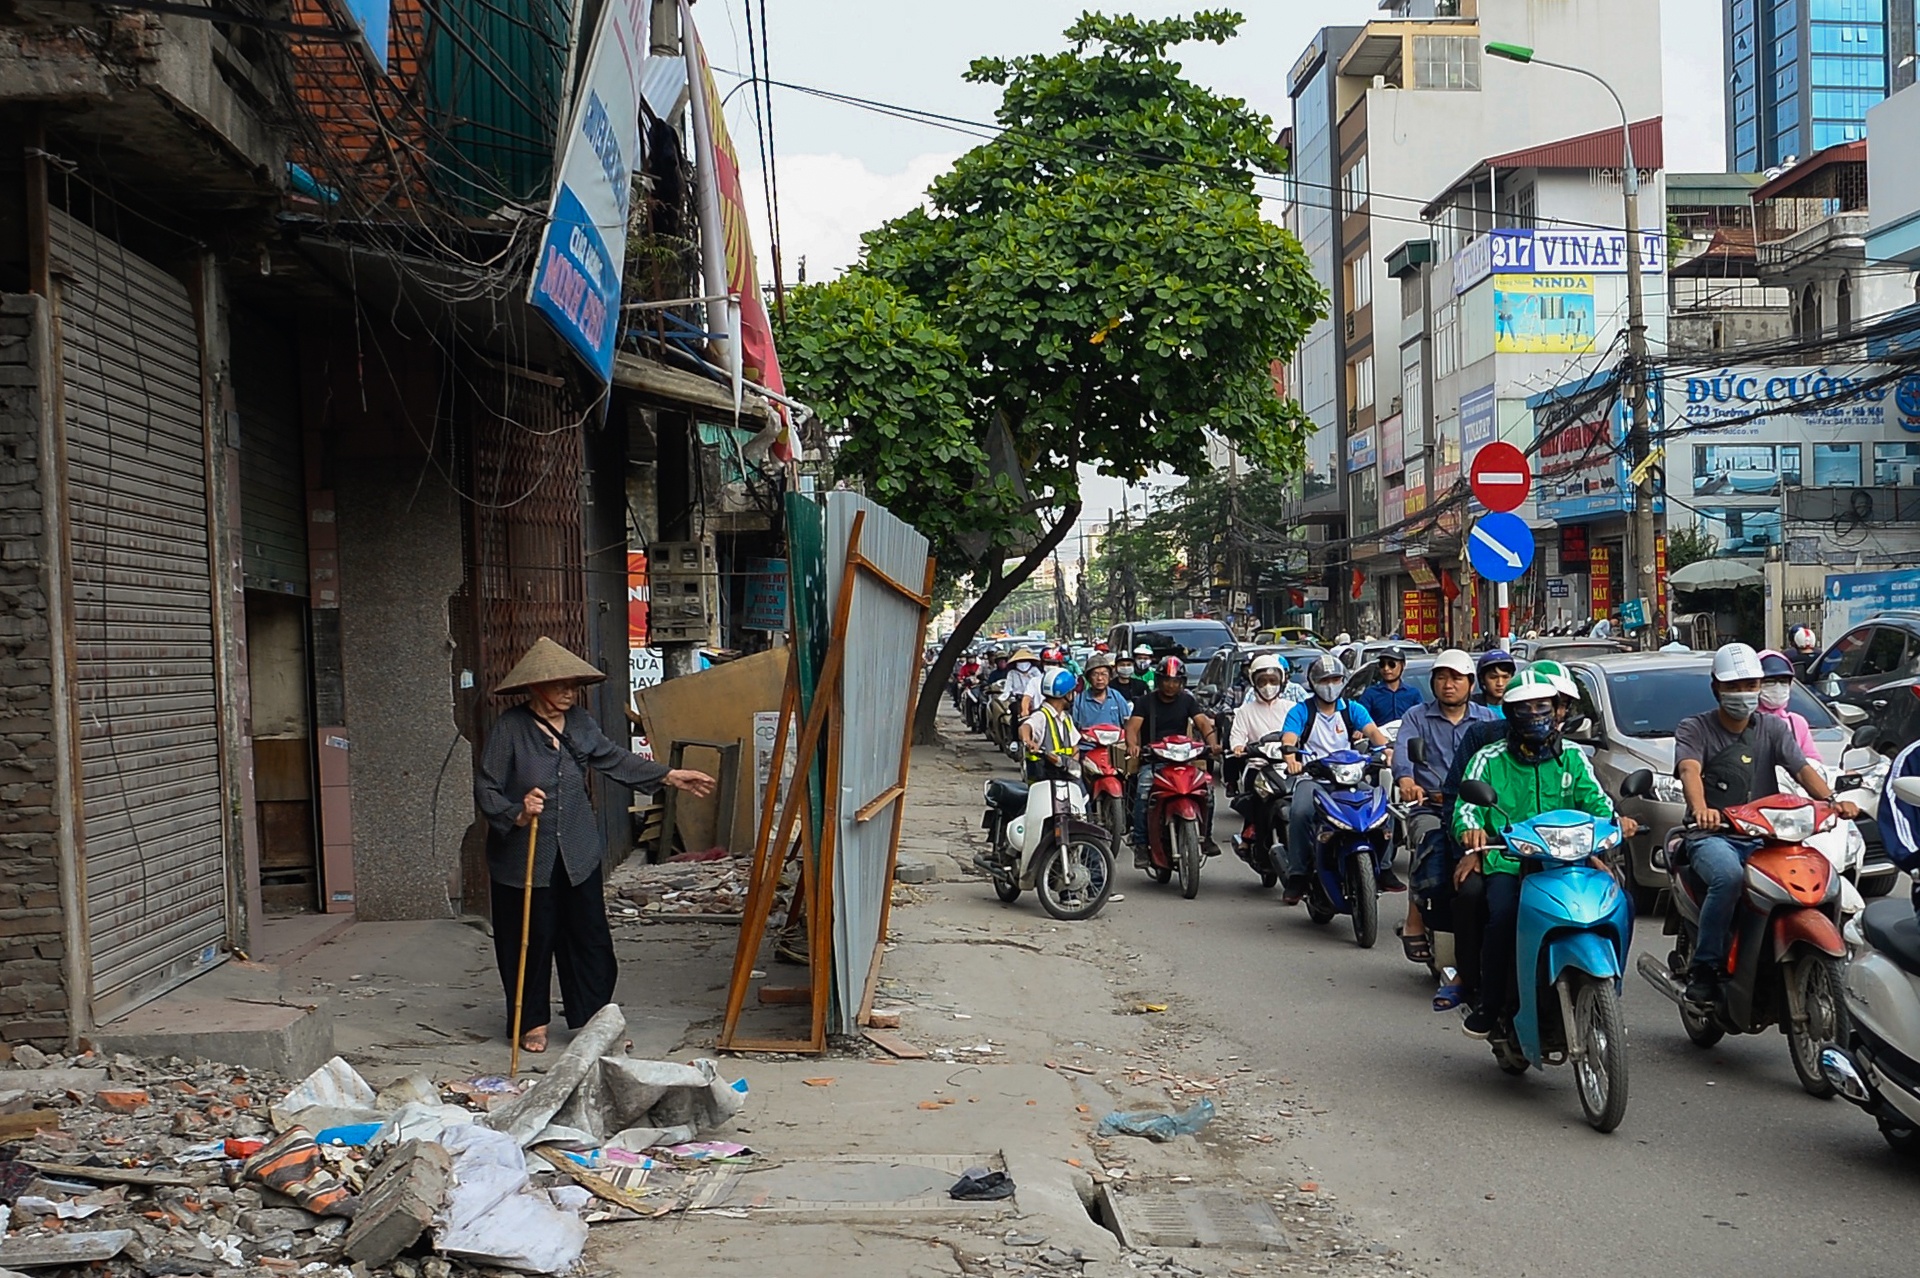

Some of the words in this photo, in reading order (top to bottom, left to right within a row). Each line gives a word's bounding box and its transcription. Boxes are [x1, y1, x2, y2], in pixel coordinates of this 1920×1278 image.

[1492, 236, 1532, 267] 217
[1539, 236, 1660, 265] VINAFT
[1687, 368, 1757, 403] ĐỨC
[1687, 405, 1710, 418] 223
[1591, 547, 1609, 560] 221
[1593, 584, 1607, 600] MÁY
